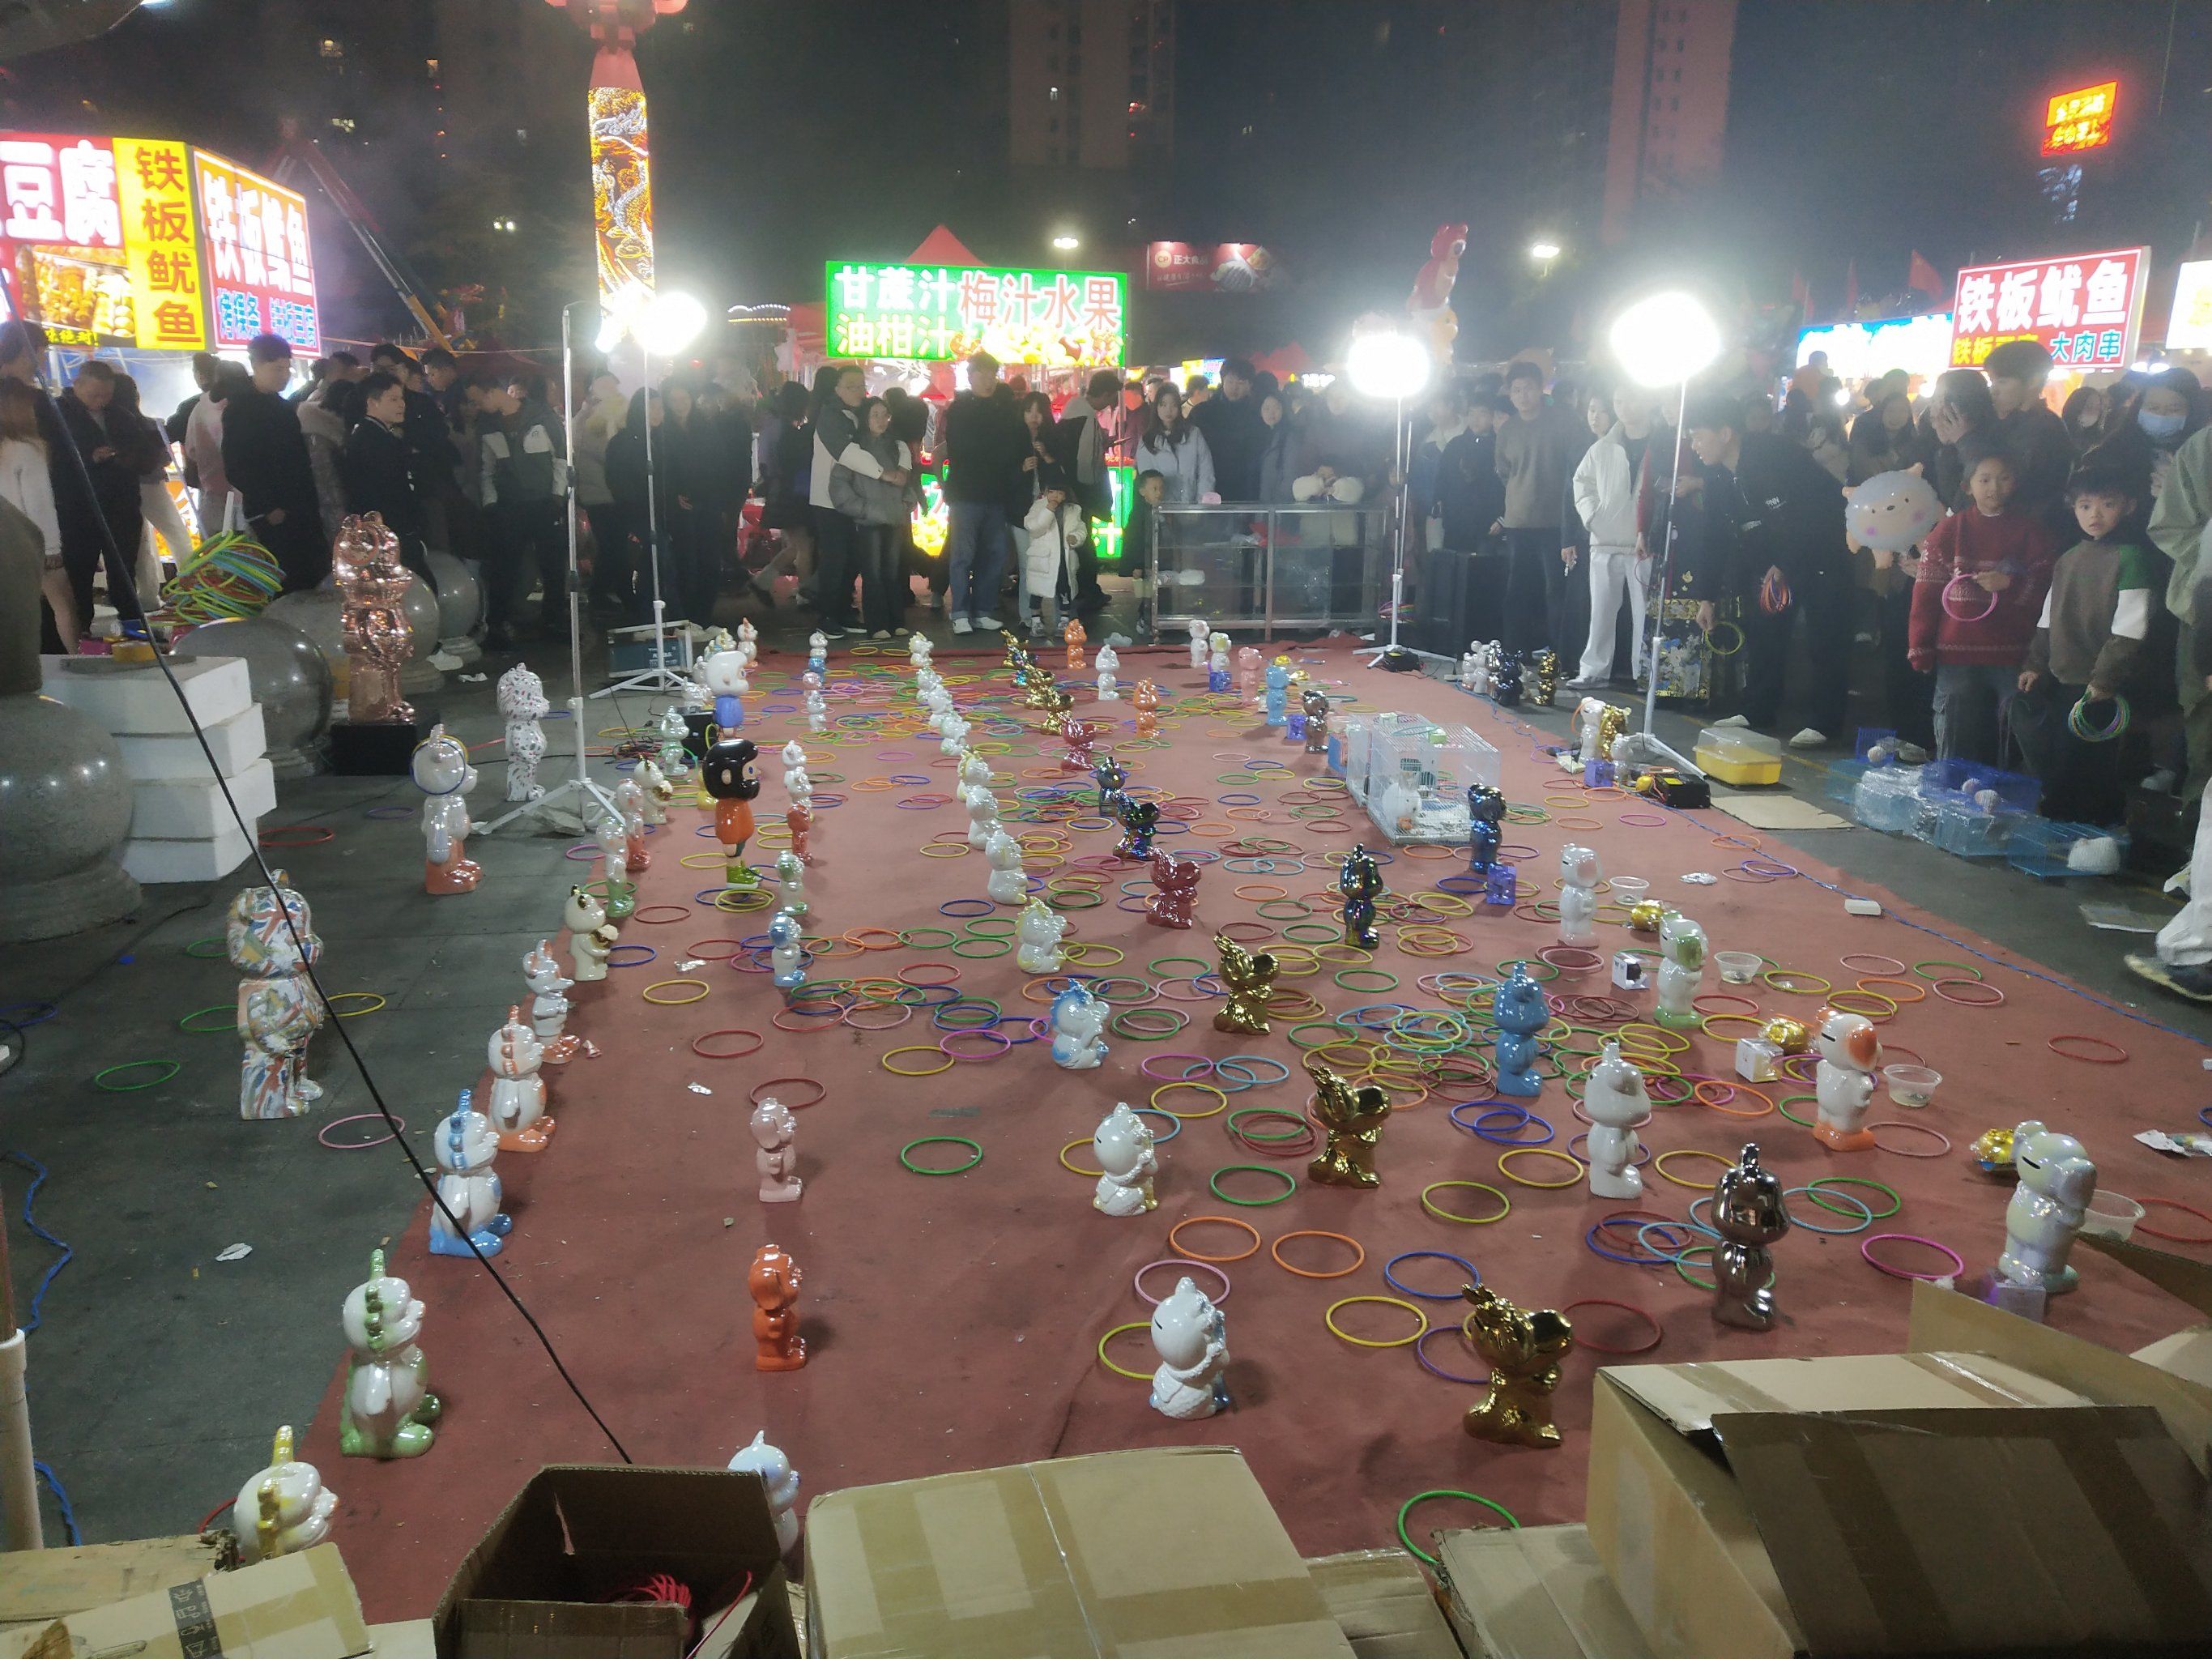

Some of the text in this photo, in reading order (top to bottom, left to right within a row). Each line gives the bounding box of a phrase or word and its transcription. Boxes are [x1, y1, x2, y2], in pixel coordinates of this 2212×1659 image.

[0, 139, 121, 245] 豆腐
[135, 146, 201, 343] 铁板鱿鱼
[203, 169, 313, 296] 铁板鱿鱼
[834, 265, 955, 310] 甘蔗汁
[958, 271, 1121, 330] 梅汁水果
[1958, 258, 2128, 334] 铁板鱿鱼
[836, 313, 953, 357] 油柑汁
[1953, 334, 2039, 365] 铁板
[2049, 329, 2121, 362] 大肉串
